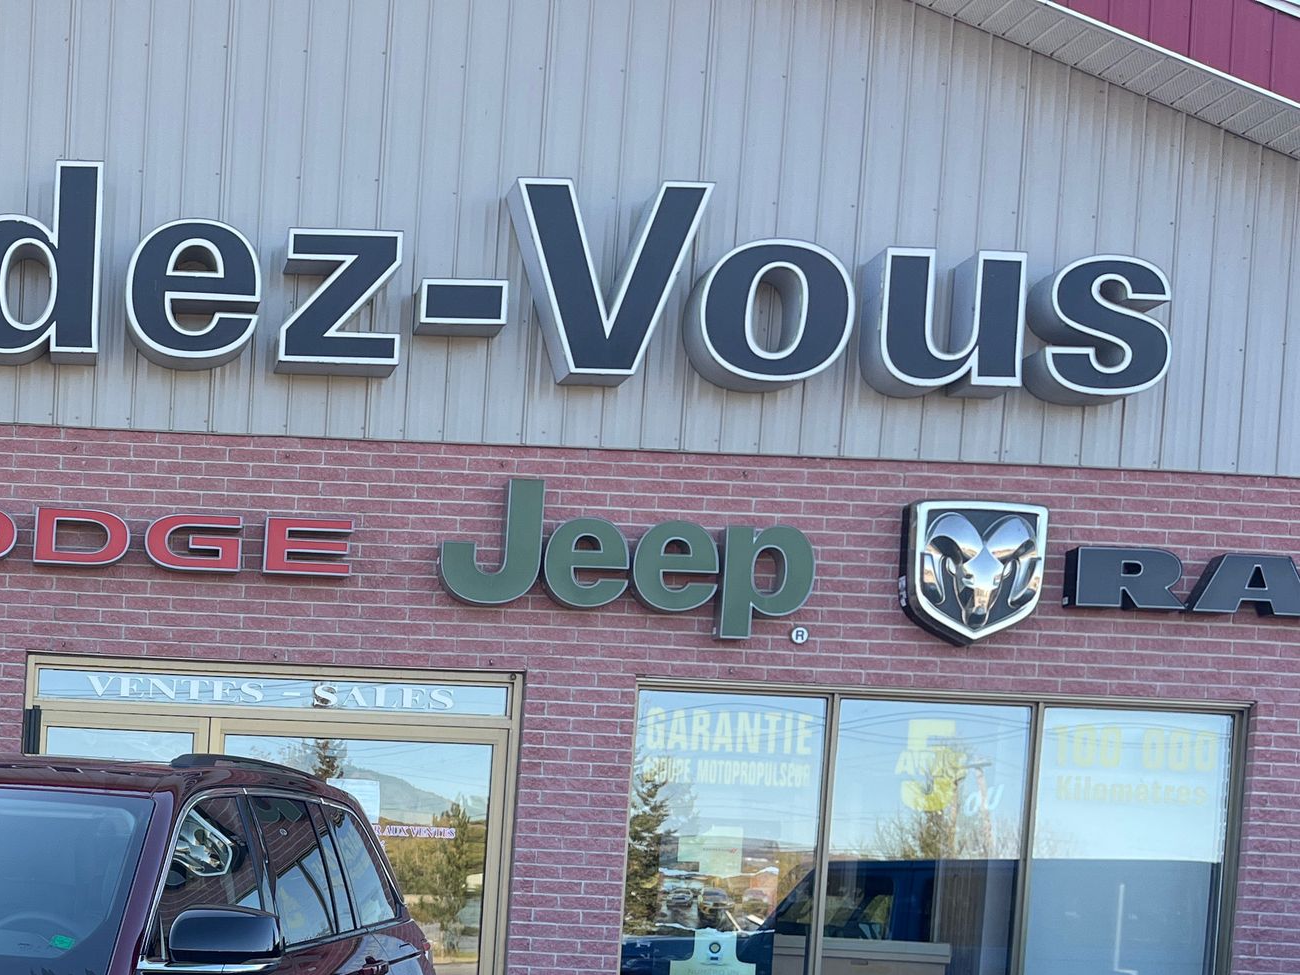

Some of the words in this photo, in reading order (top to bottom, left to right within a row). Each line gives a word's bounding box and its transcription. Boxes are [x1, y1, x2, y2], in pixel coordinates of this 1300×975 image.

[438, 478, 816, 641] Jeep
[86, 674, 264, 703] VENTES
[311, 684, 455, 710] SALES
[646, 706, 814, 755] GARANTIE
[901, 719, 956, 812] 5
[410, 826, 456, 839] VENTES
